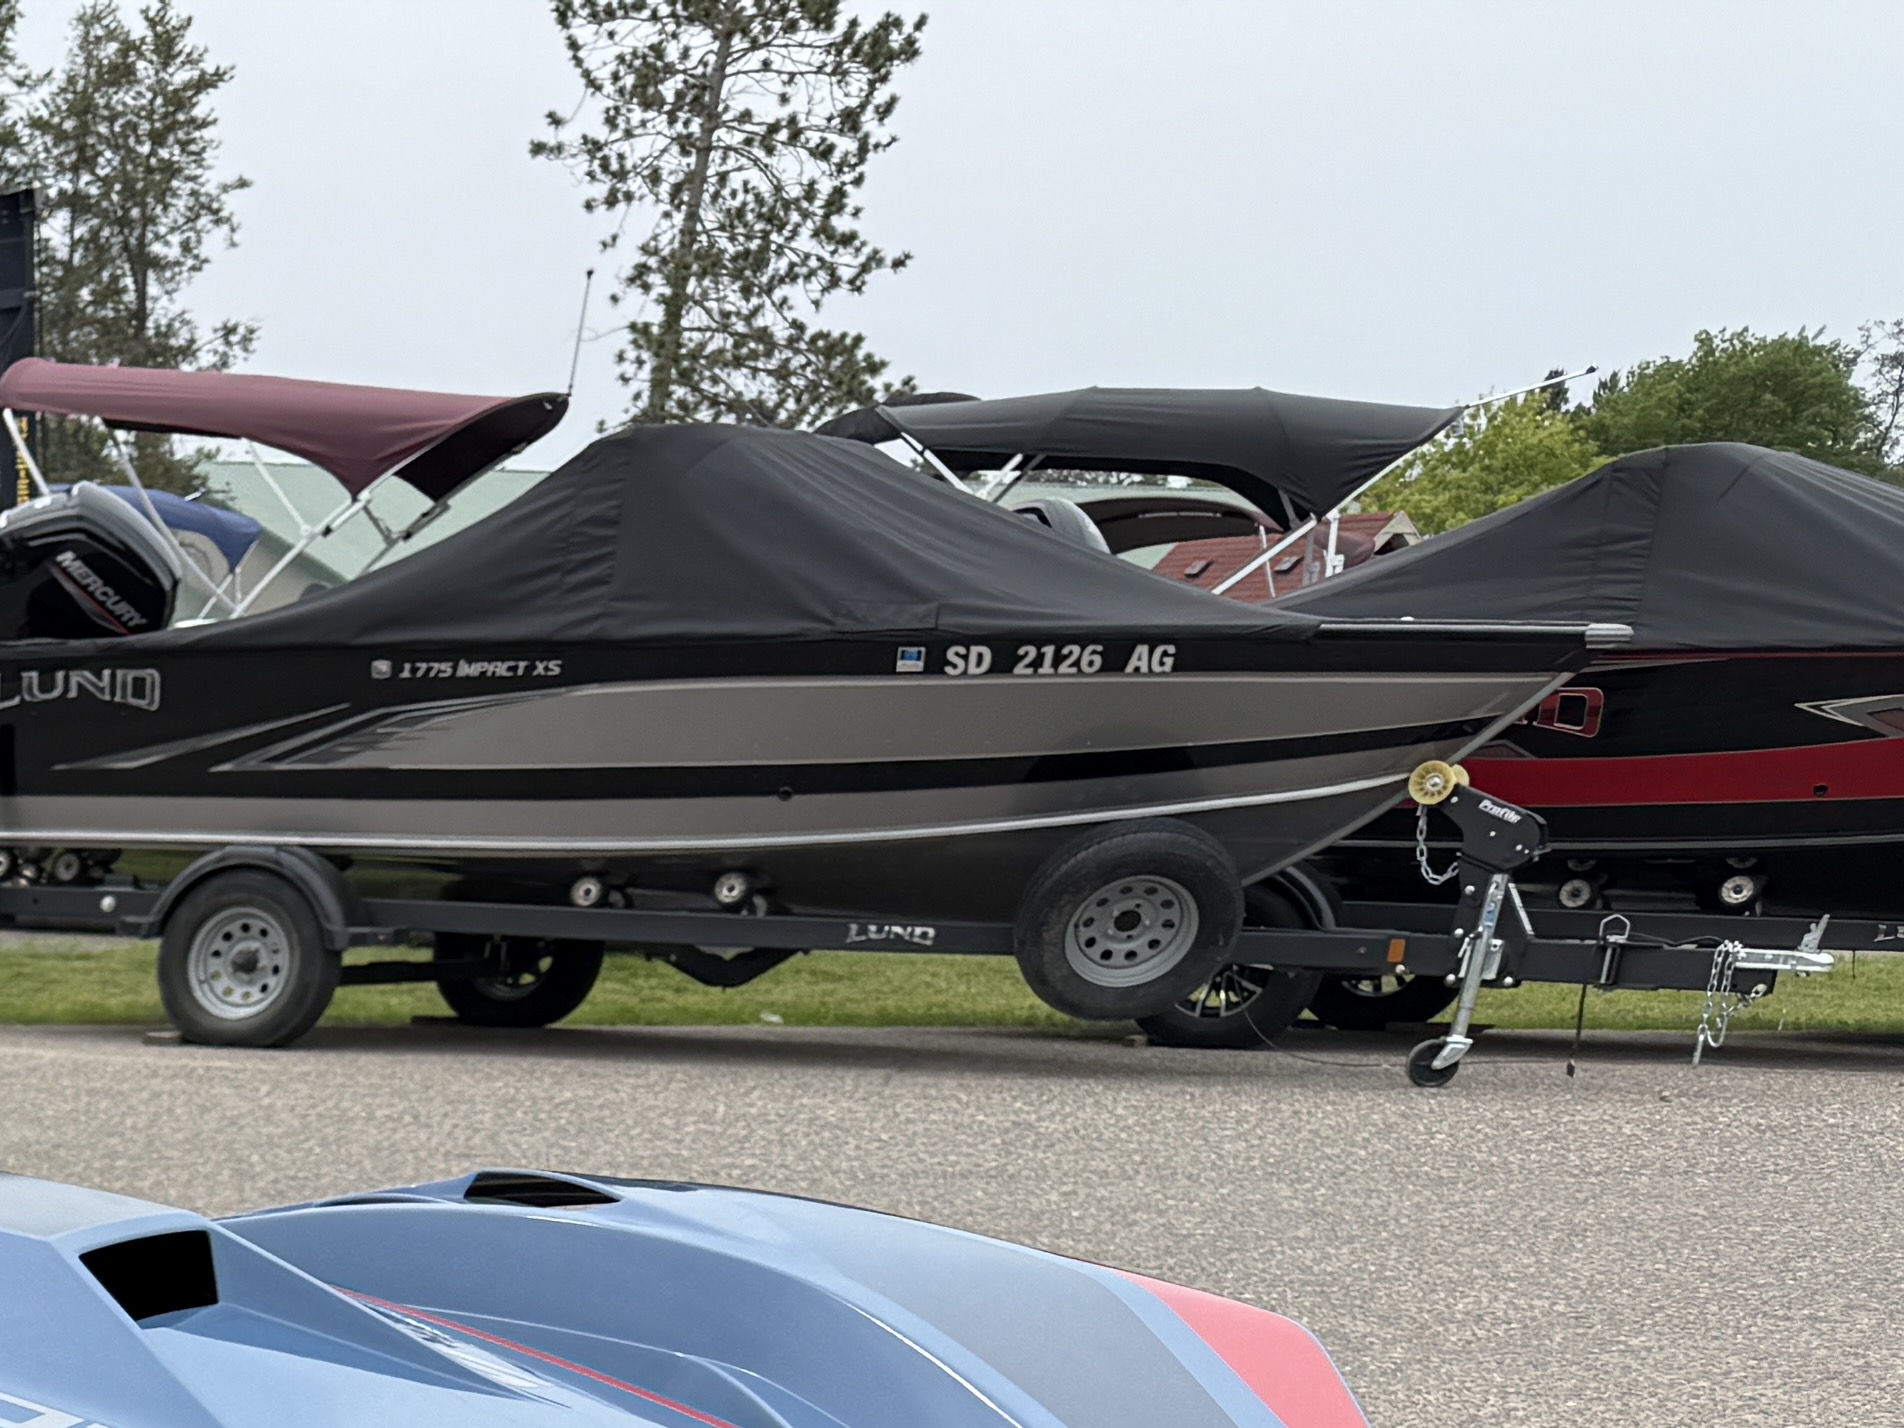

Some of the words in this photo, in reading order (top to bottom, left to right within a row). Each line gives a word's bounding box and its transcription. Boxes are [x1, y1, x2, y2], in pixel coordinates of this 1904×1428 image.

[56, 550, 149, 628] MERCURY
[398, 662, 454, 678] 1775
[455, 659, 529, 678] IMPACT
[532, 660, 563, 676] XS
[943, 645, 993, 676] SD
[1012, 644, 1104, 675] 2126
[1124, 644, 1177, 674] AG
[1478, 799, 1522, 824] Profile
[845, 923, 936, 946] LUND
